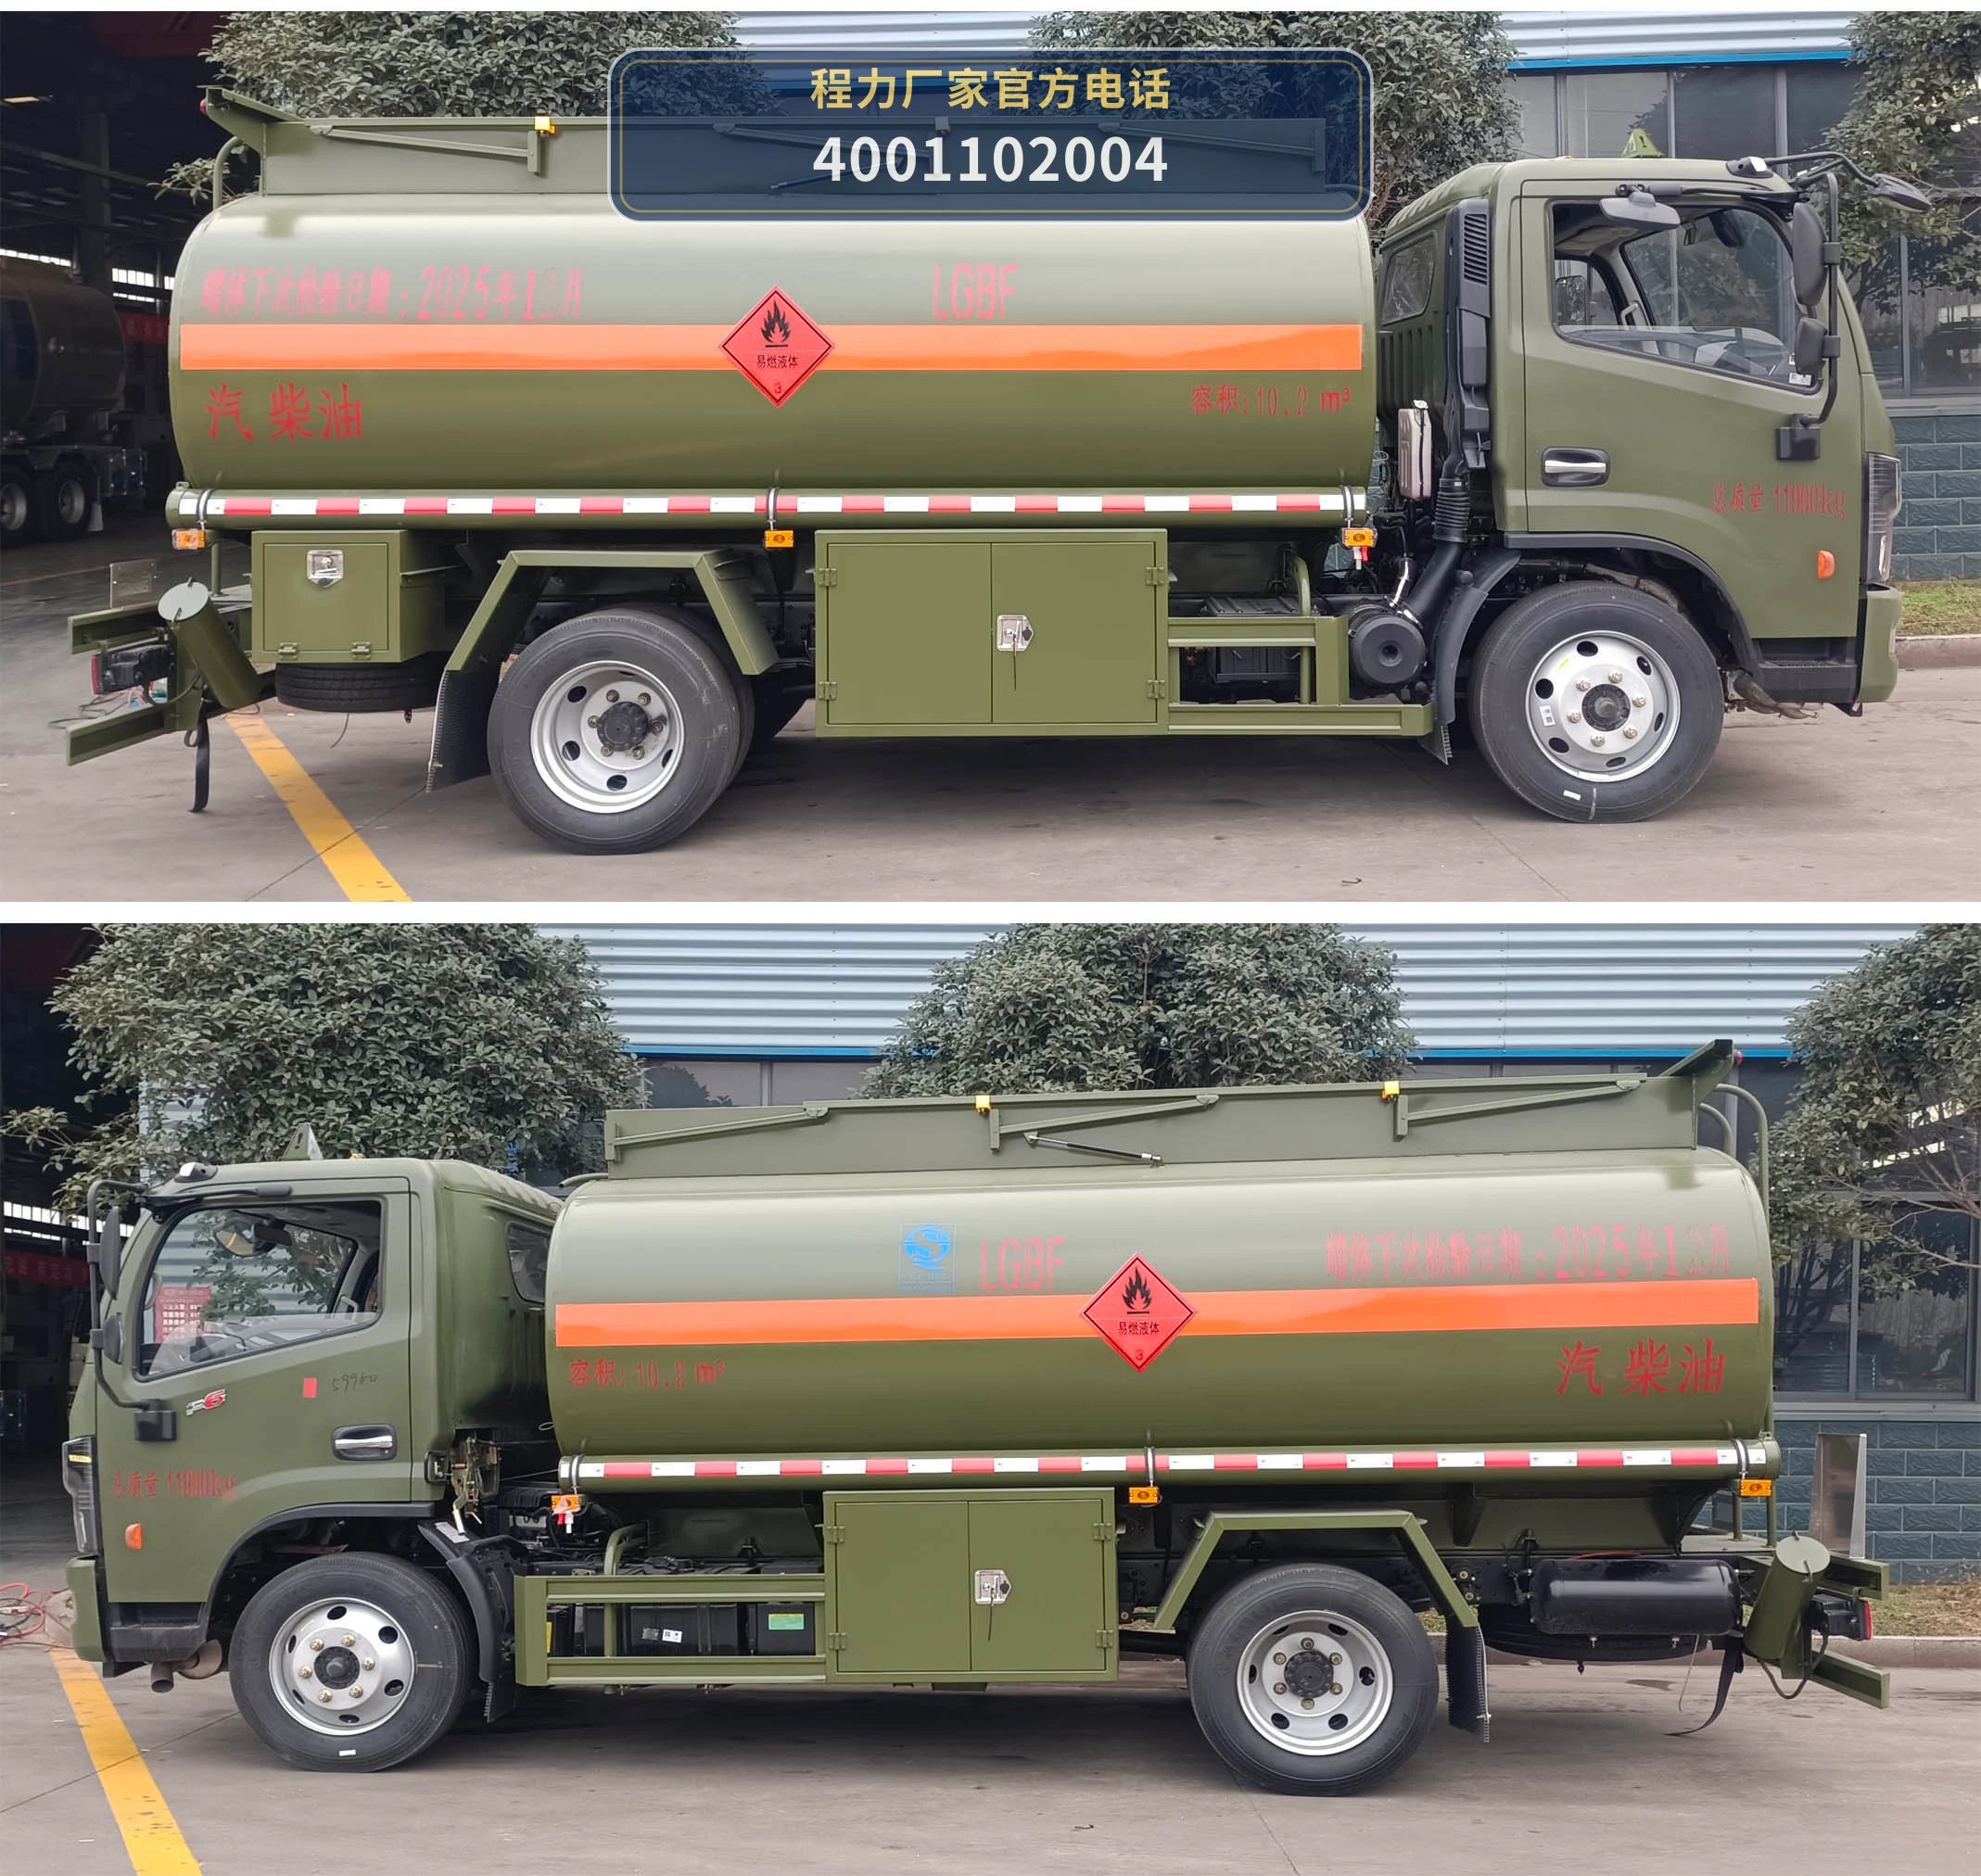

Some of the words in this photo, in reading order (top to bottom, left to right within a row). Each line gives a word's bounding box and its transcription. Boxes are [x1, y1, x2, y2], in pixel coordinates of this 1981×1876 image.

[933, 262, 1018, 320] LGBF
[756, 354, 798, 368] 易燃液体
[774, 382, 781, 394] 3
[980, 1236, 1065, 1291] LGBF
[1118, 1321, 1160, 1335] 易燃液体
[1136, 1349, 1144, 1361] 3
